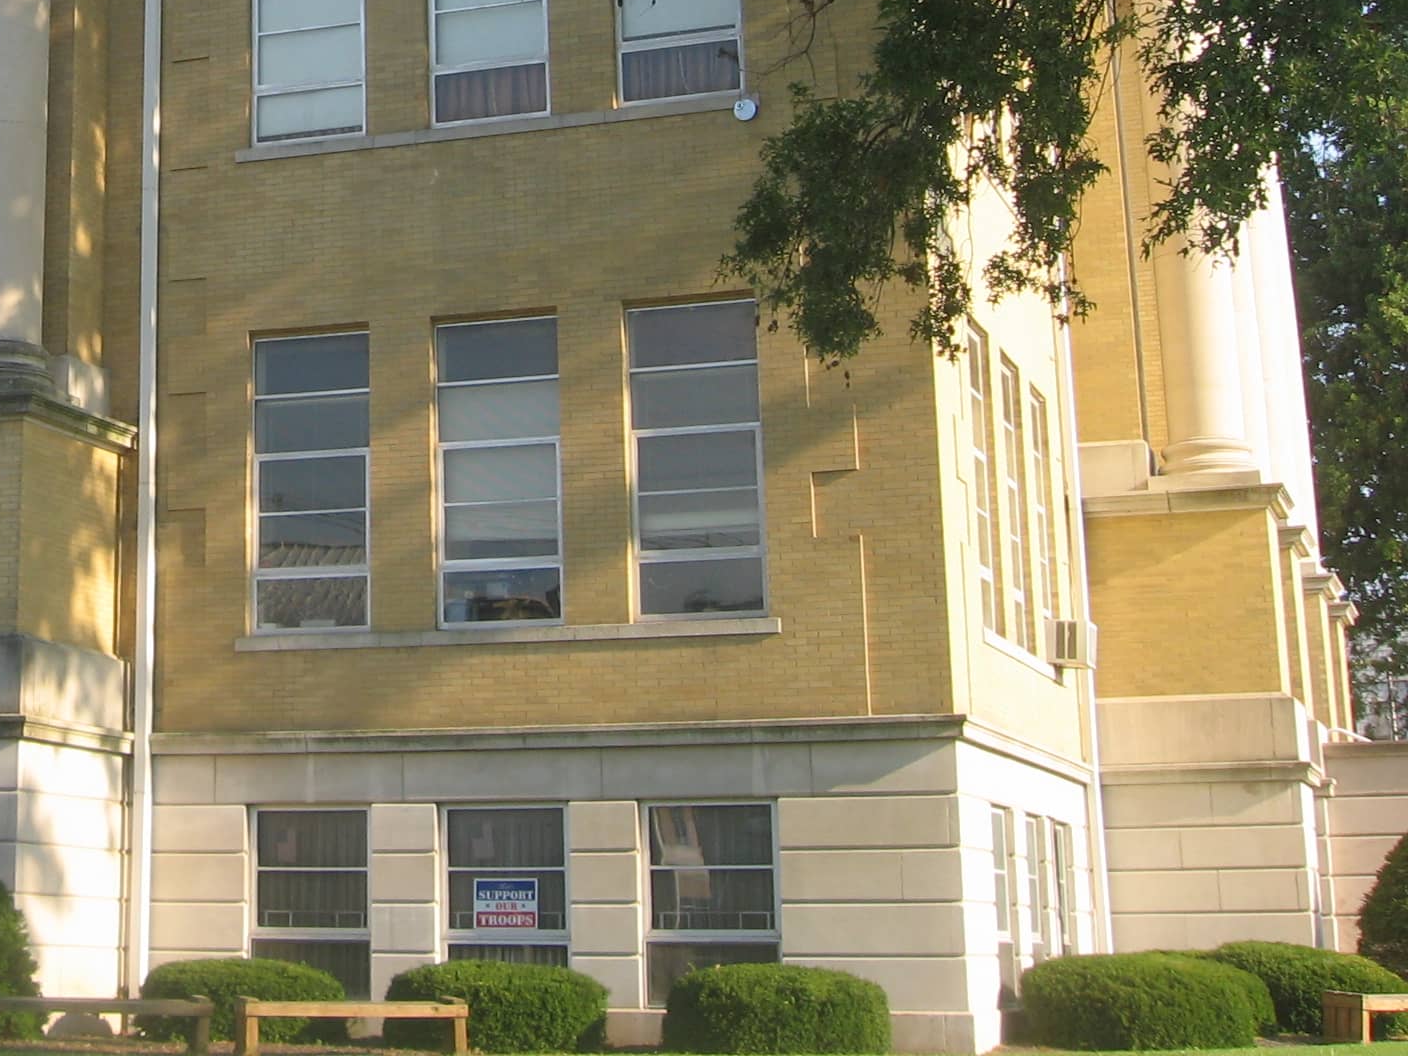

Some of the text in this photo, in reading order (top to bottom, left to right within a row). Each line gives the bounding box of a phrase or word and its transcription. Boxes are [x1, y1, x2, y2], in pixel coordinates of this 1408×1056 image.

[478, 890, 534, 900] SUPPORT
[496, 902, 518, 911] OUR
[479, 914, 534, 926] TROOPS
